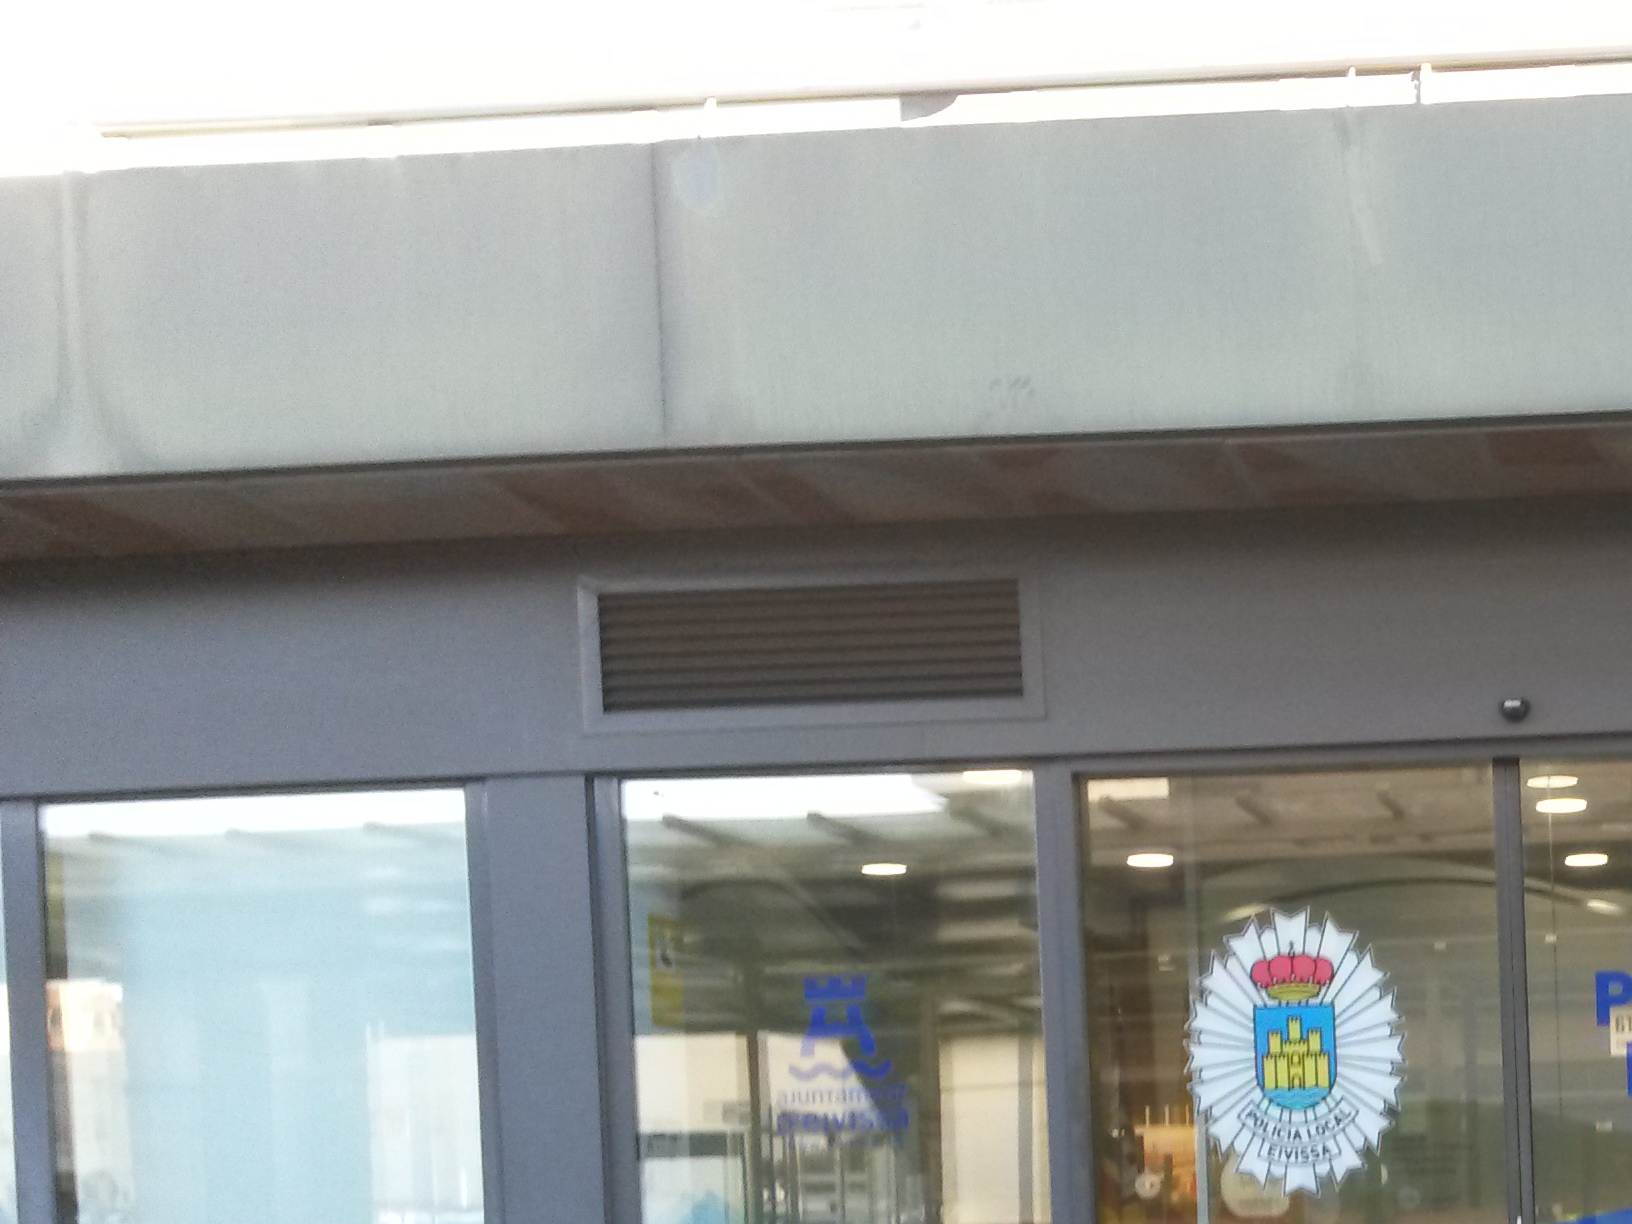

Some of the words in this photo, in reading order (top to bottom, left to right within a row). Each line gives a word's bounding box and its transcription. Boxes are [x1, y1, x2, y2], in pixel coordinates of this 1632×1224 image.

[1245, 1109, 1302, 1141] POLICIA
[1306, 1105, 1353, 1139] LOCAL
[1267, 1142, 1332, 1162] EIVISSA
